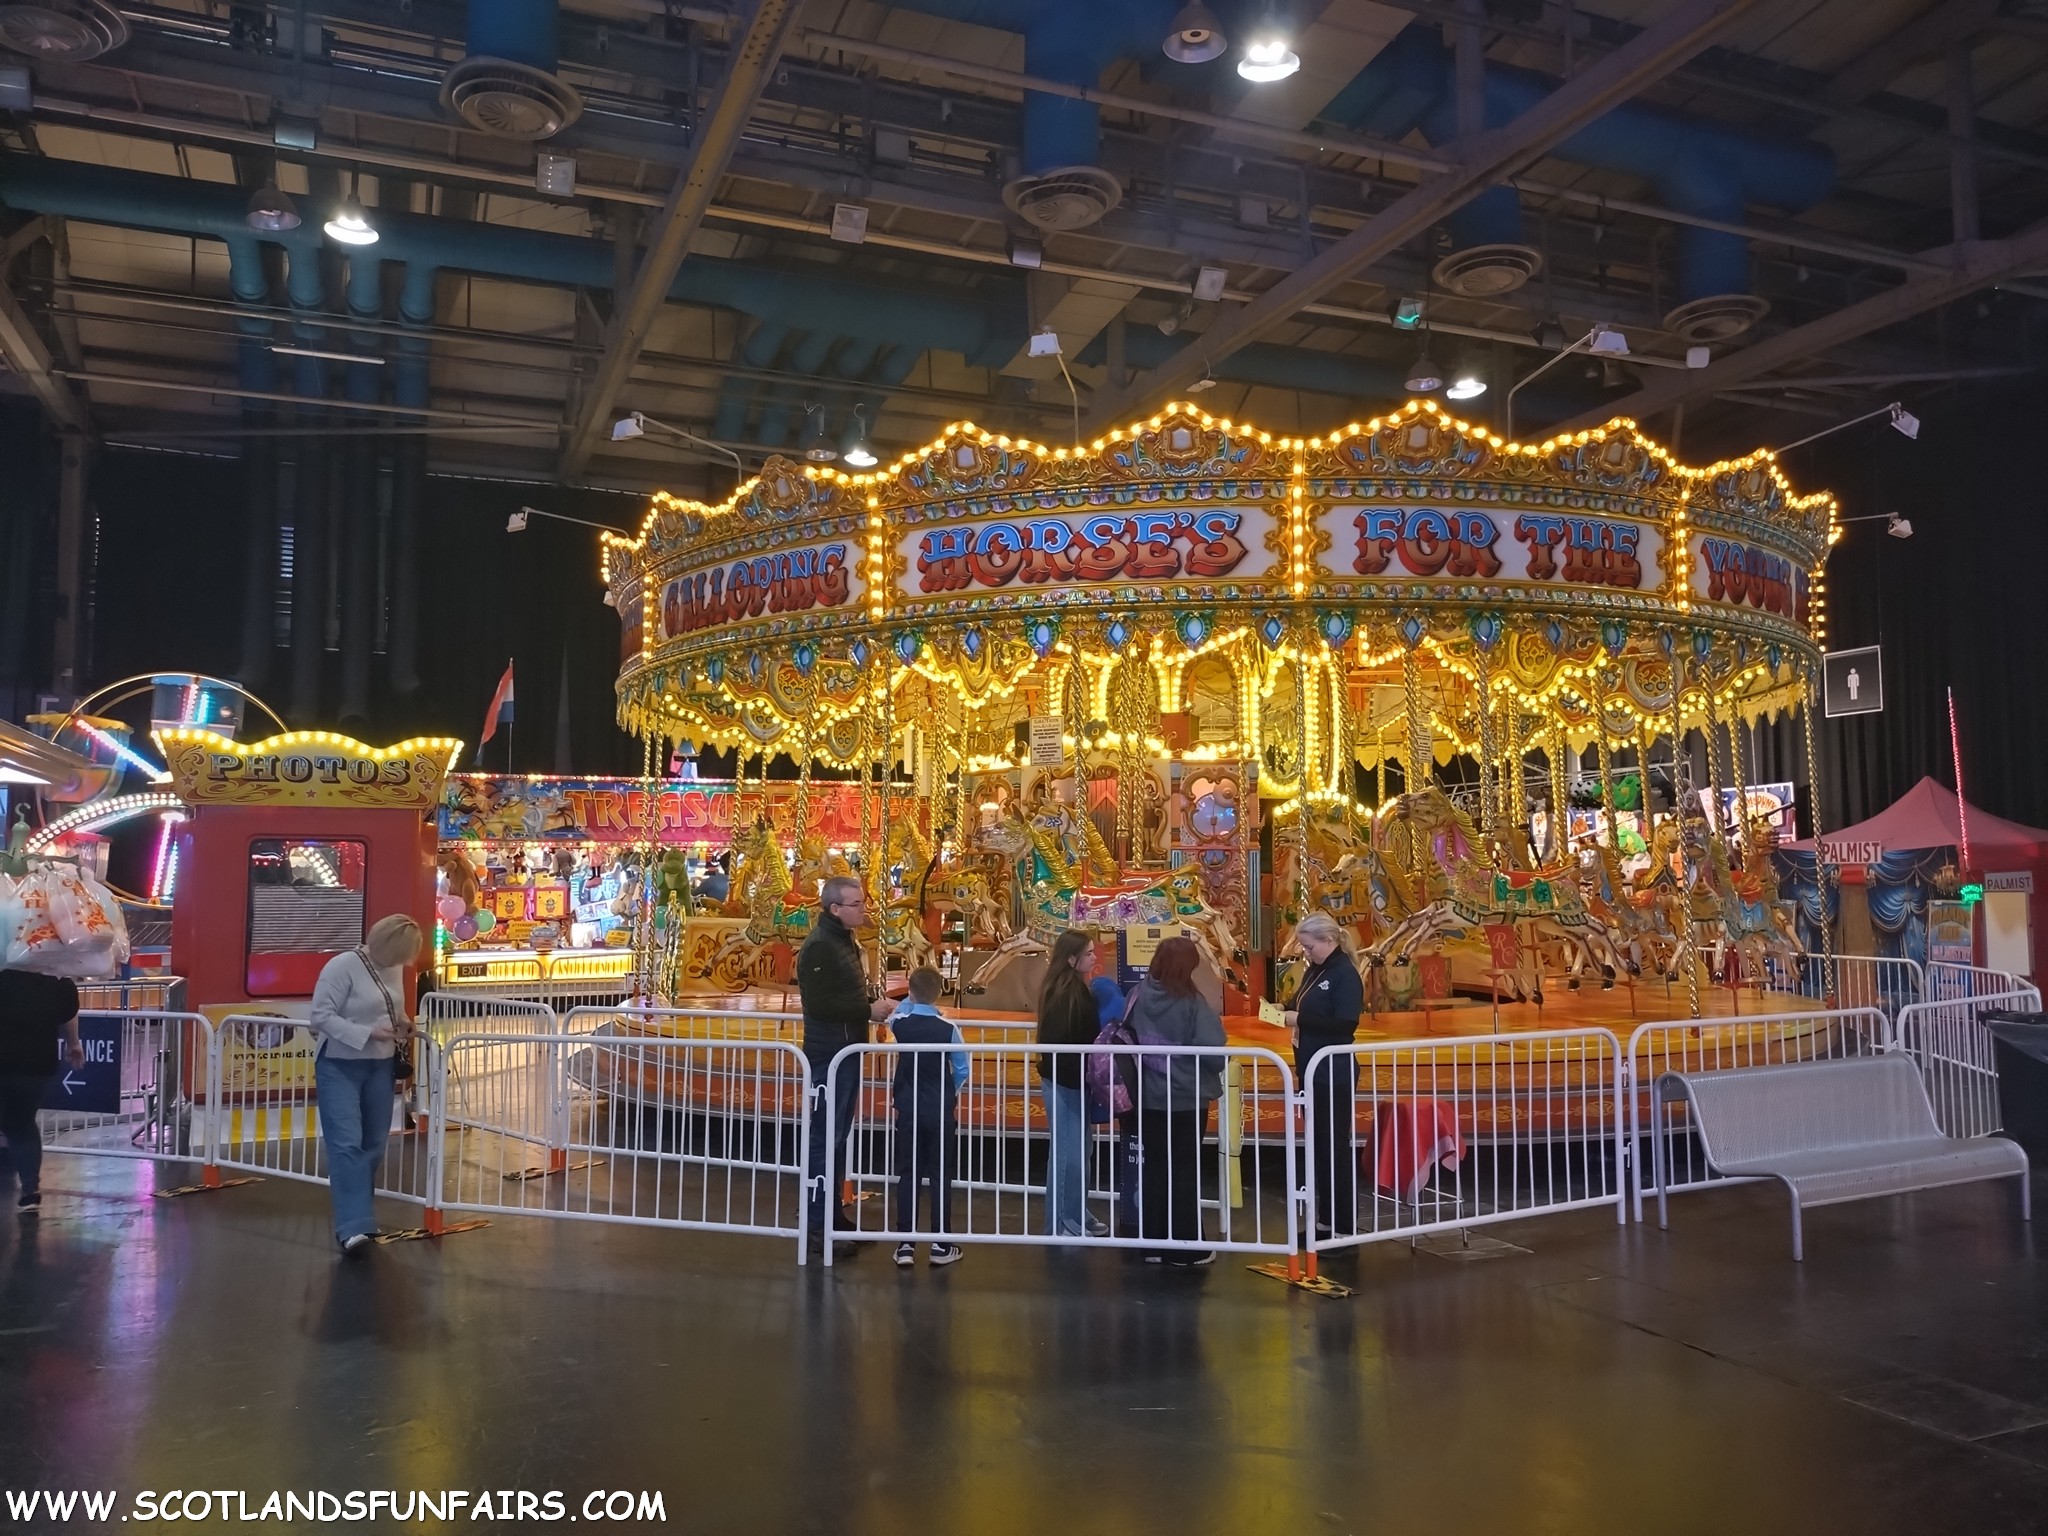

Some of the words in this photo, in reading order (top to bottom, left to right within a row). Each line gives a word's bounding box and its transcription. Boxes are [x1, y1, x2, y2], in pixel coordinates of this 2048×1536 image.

[919, 509, 1247, 593] HORSE'S
[1352, 508, 1502, 577] FOR
[1513, 514, 1642, 589] THE
[663, 543, 850, 639] GALLOPING
[206, 752, 411, 787] PHOTOS
[1821, 842, 1880, 863] PALMIST
[1987, 876, 2031, 890] PALMIST
[461, 965, 483, 976] EXIT
